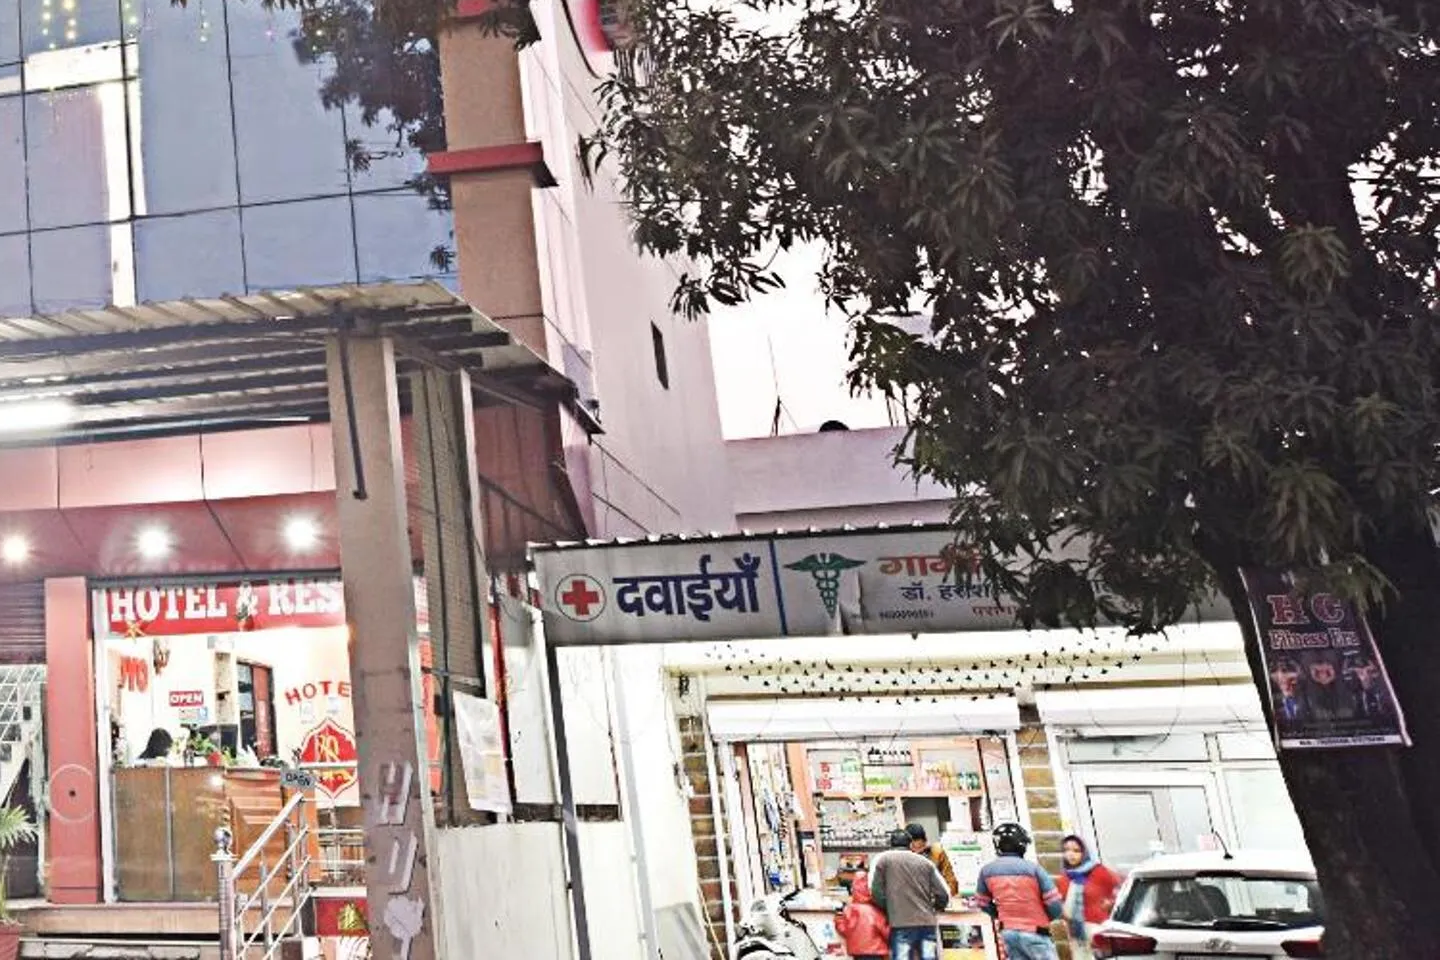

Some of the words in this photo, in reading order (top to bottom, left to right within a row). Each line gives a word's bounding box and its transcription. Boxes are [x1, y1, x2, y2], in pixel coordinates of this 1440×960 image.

[110, 584, 227, 622] HOTEL
[613, 553, 761, 622] दवाईयाँ
[170, 692, 203, 705] OPEN
